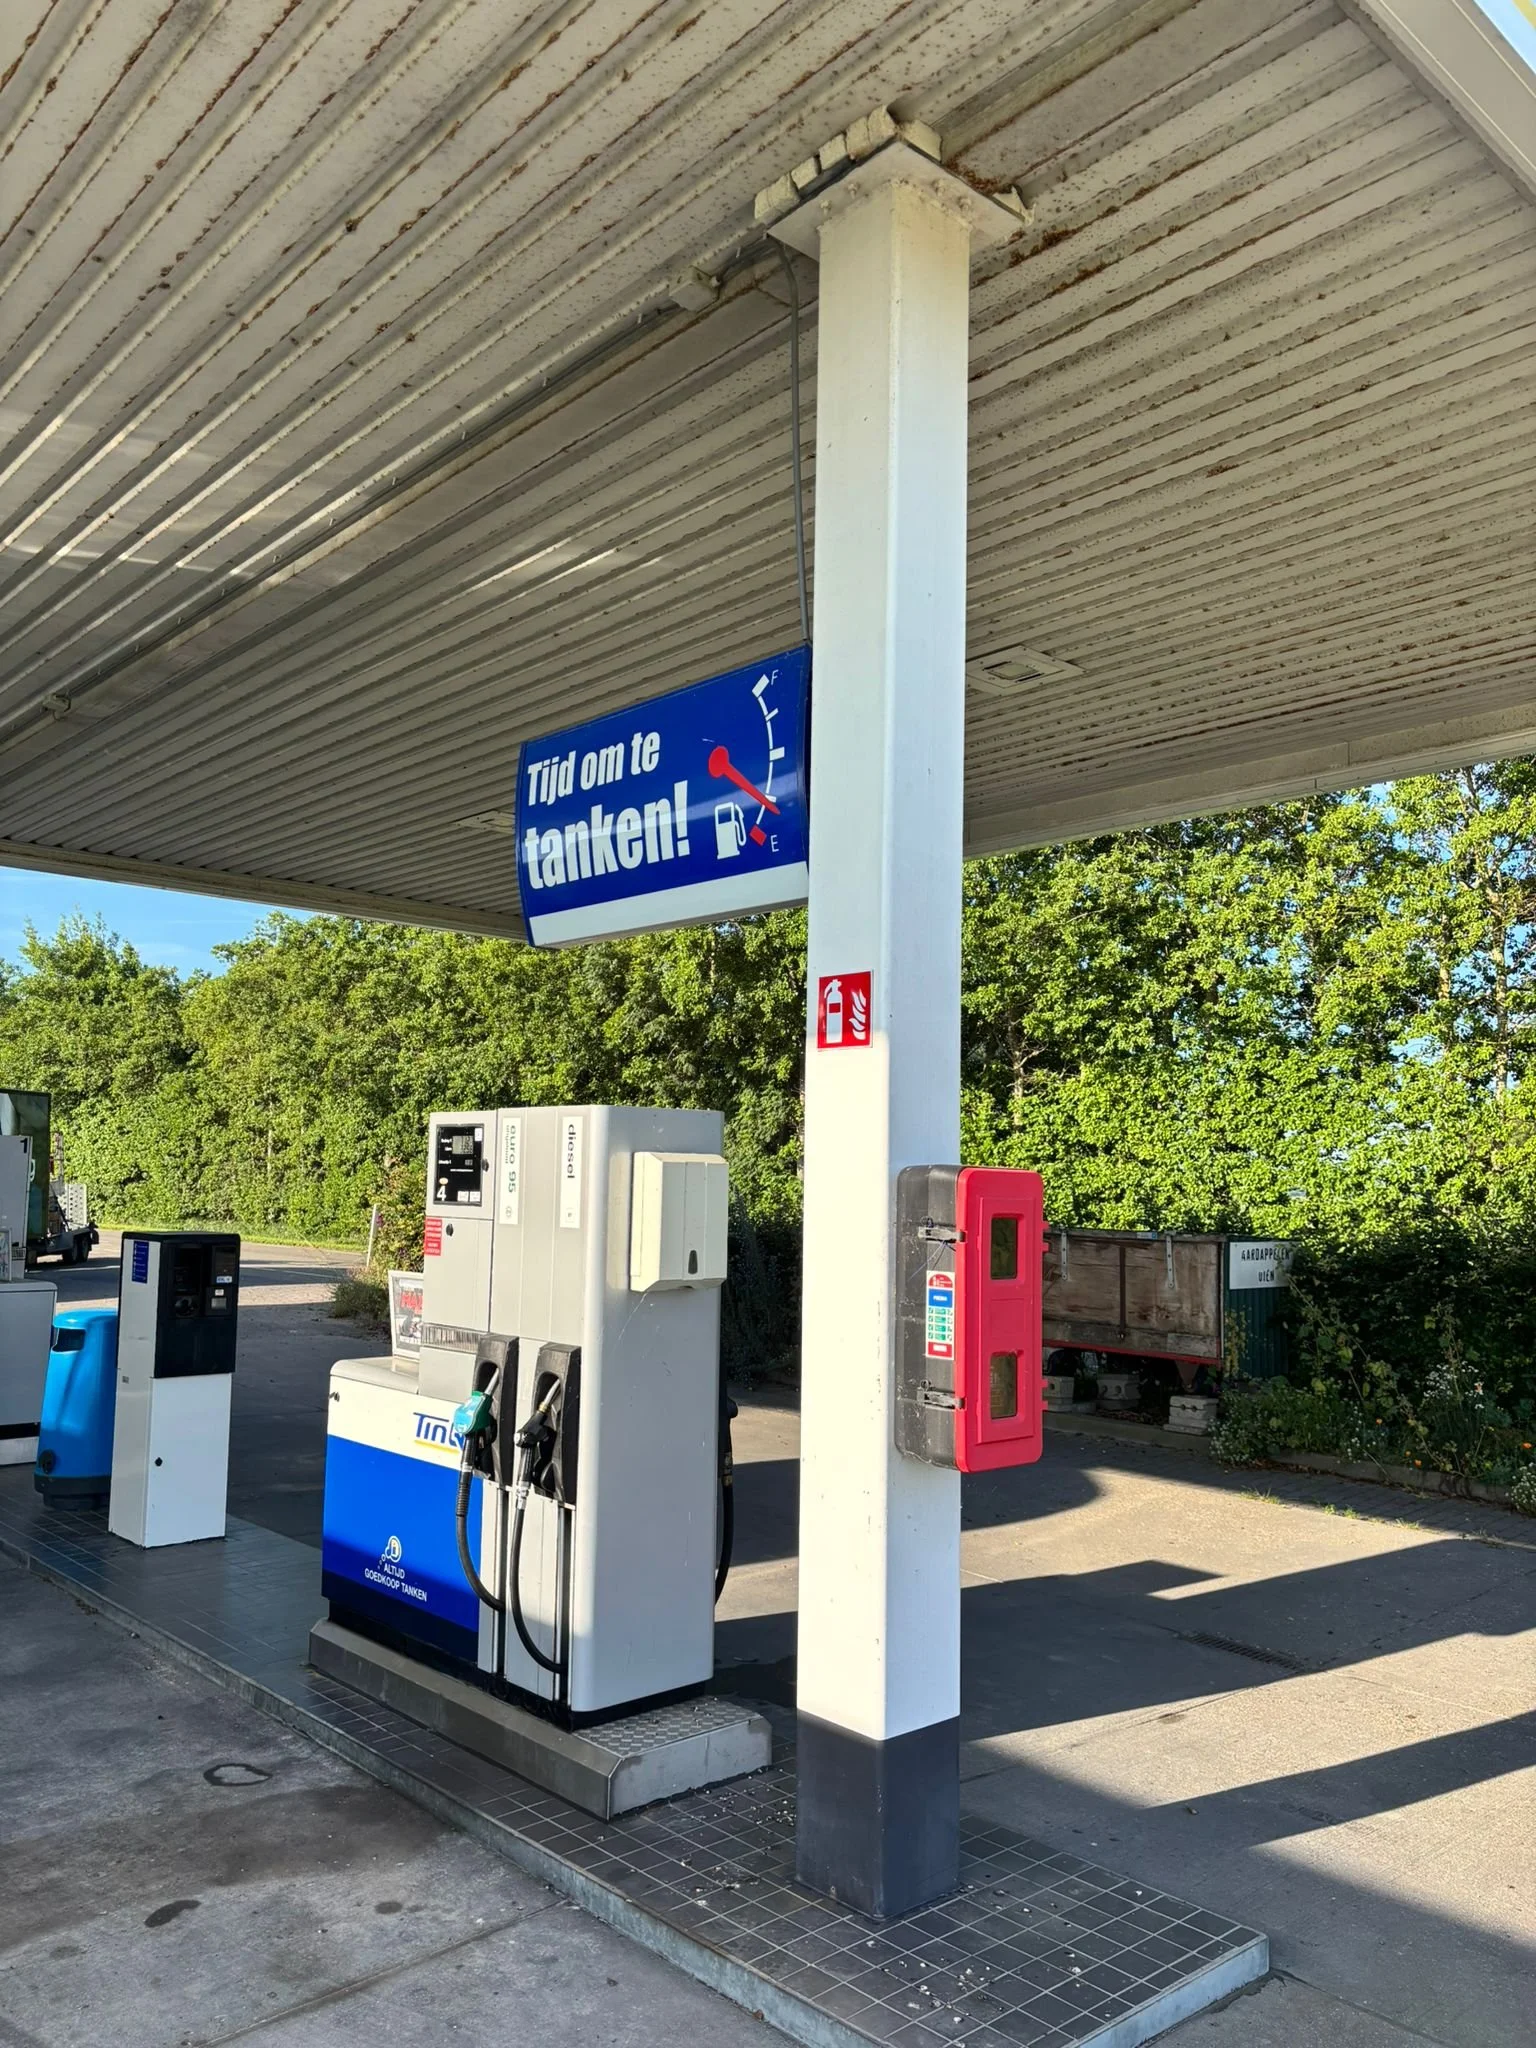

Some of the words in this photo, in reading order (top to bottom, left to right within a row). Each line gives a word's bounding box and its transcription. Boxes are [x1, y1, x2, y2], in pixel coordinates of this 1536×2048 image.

[770, 670, 779, 686] F
[527, 750, 577, 806] Tijd
[580, 742, 625, 791] om
[631, 731, 661, 776] te
[524, 780, 690, 890] tanken!
[770, 835, 780, 852] E
[20, 1137, 28, 1154] 1
[567, 1123, 577, 1179] diesel
[508, 1171, 517, 1193] 95
[436, 1185, 447, 1202] 4
[384, 1563, 405, 1579] ALTIJD
[364, 1567, 400, 1590] GOEDKOOP
[401, 1582, 428, 1602] TANKEN
